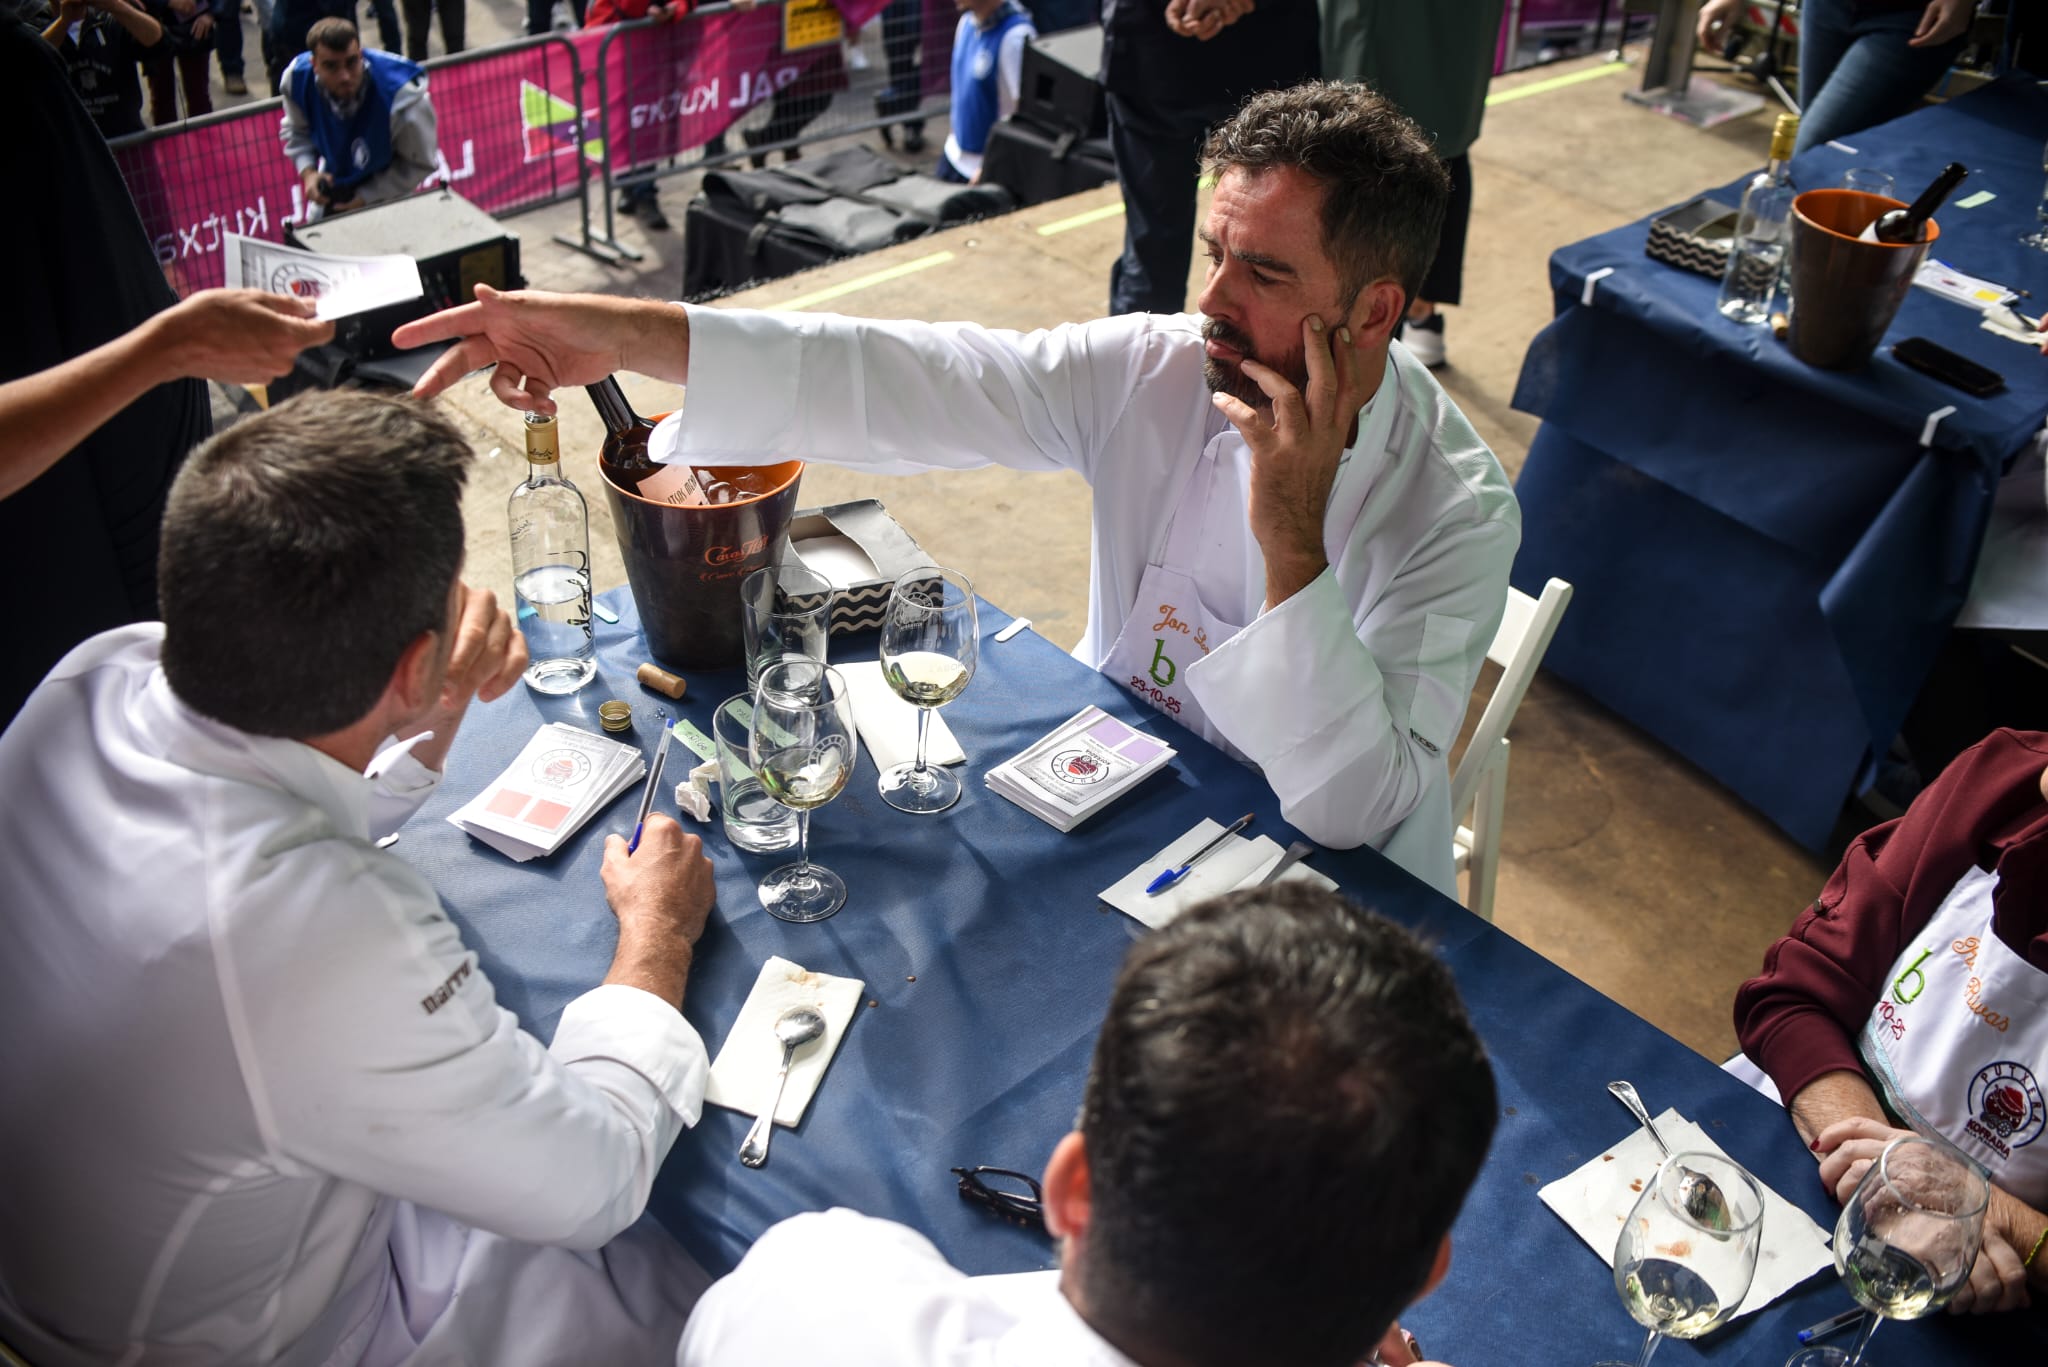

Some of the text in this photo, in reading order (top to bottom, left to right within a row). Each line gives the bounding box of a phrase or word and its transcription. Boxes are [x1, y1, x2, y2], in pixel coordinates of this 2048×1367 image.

[1153, 604, 1190, 634] Jon
[1130, 675, 1182, 714] 23-10-25
[1980, 1062, 2042, 1124] PUTXERA
[1965, 1118, 2011, 1159] KOFRADIA
